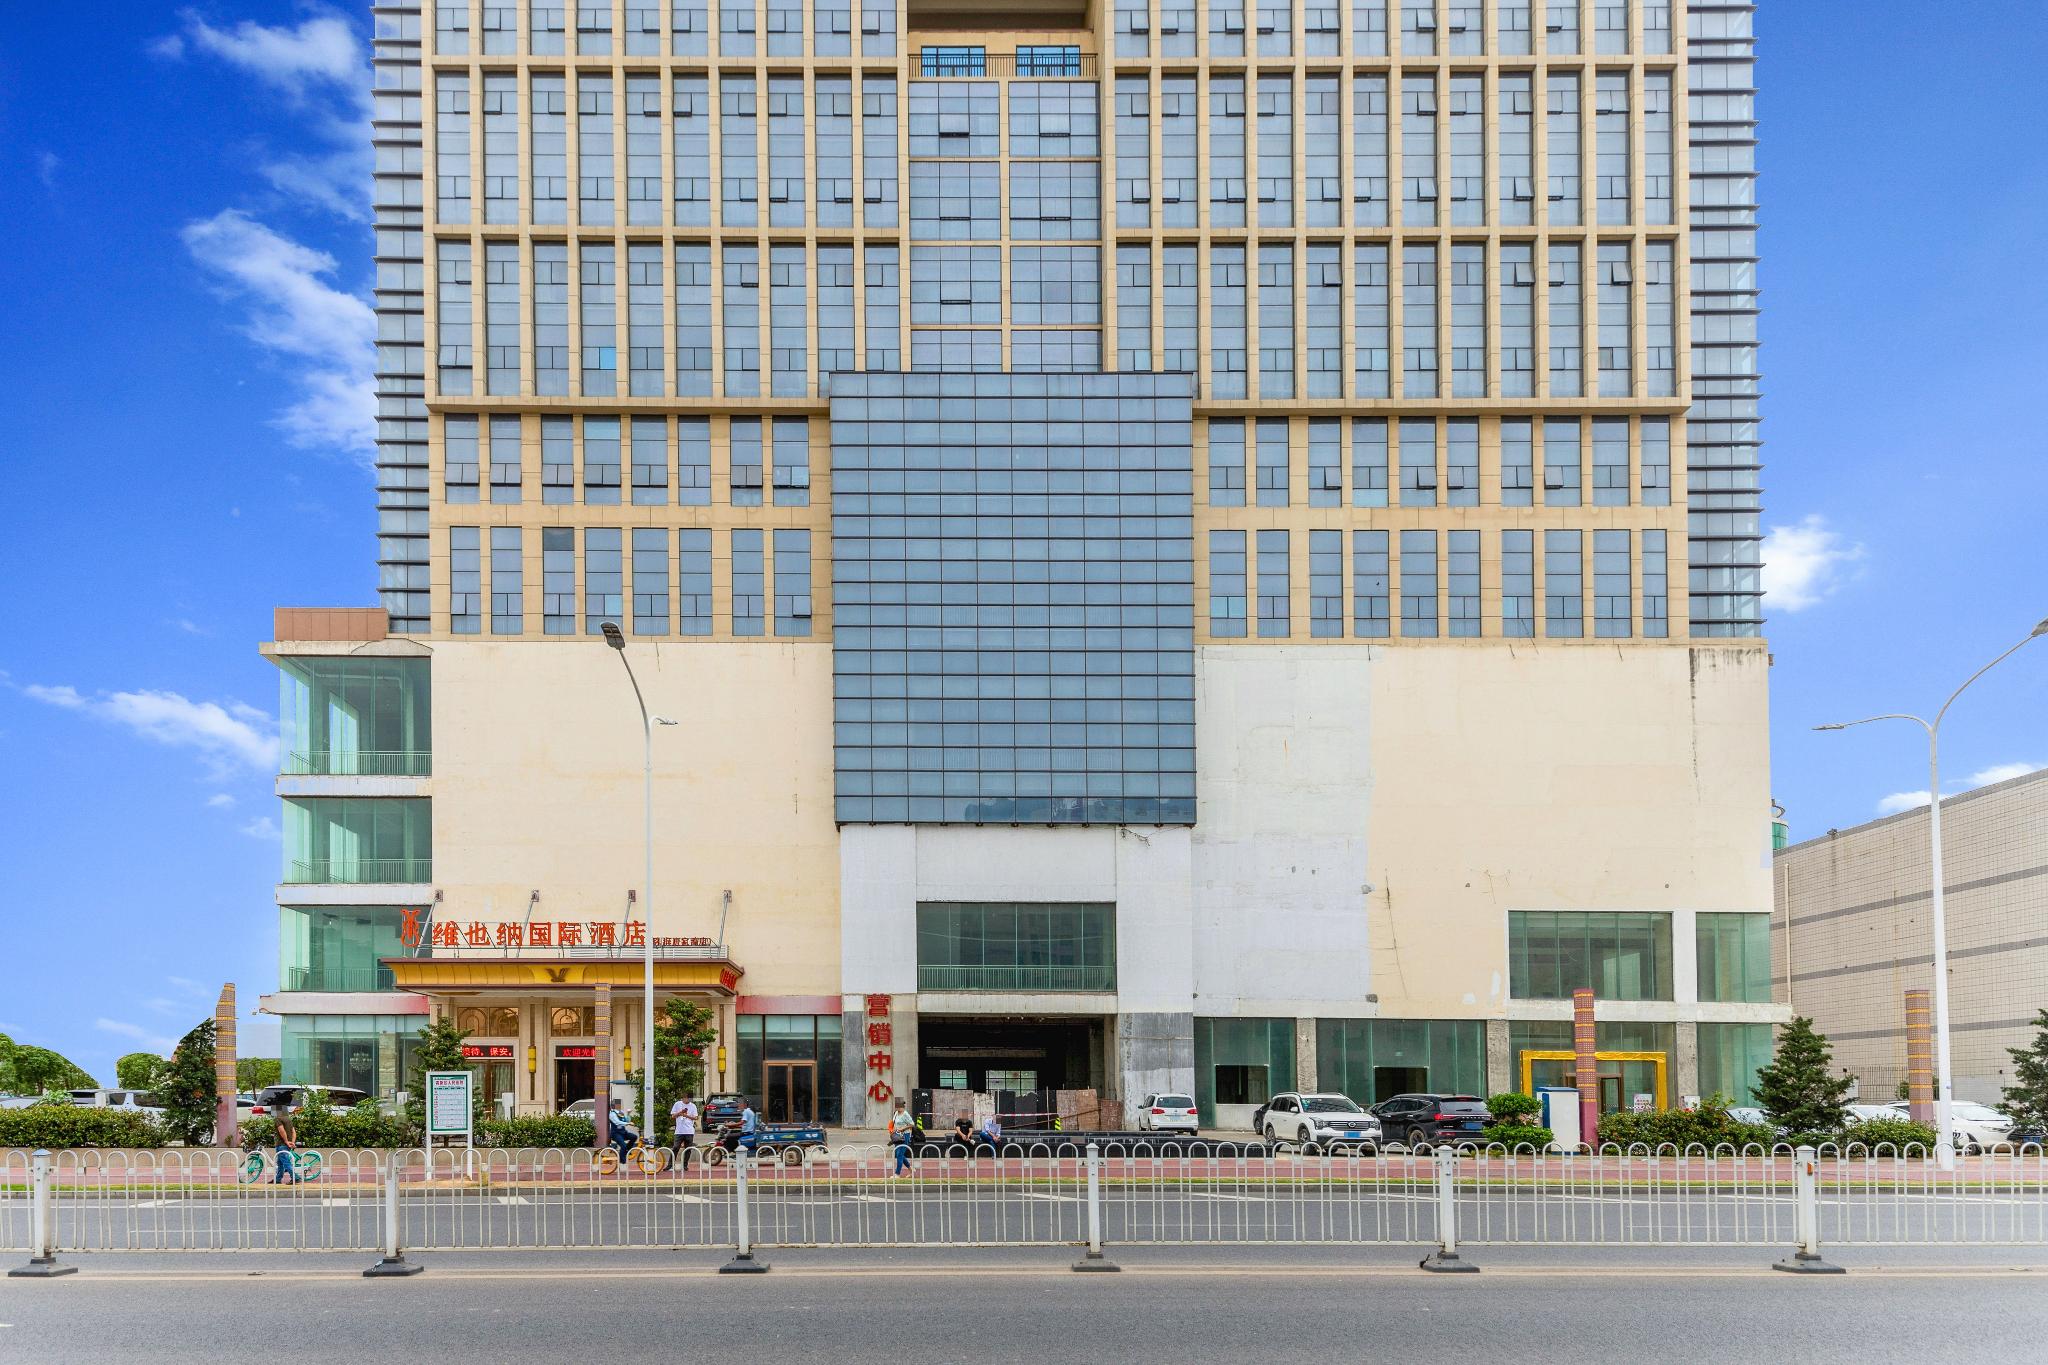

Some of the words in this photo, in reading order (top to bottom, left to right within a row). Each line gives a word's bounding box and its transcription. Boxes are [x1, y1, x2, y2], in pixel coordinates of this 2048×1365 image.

[432, 921, 646, 947] 维也纳国际酒店
[867, 993, 893, 1103] 营销中心
